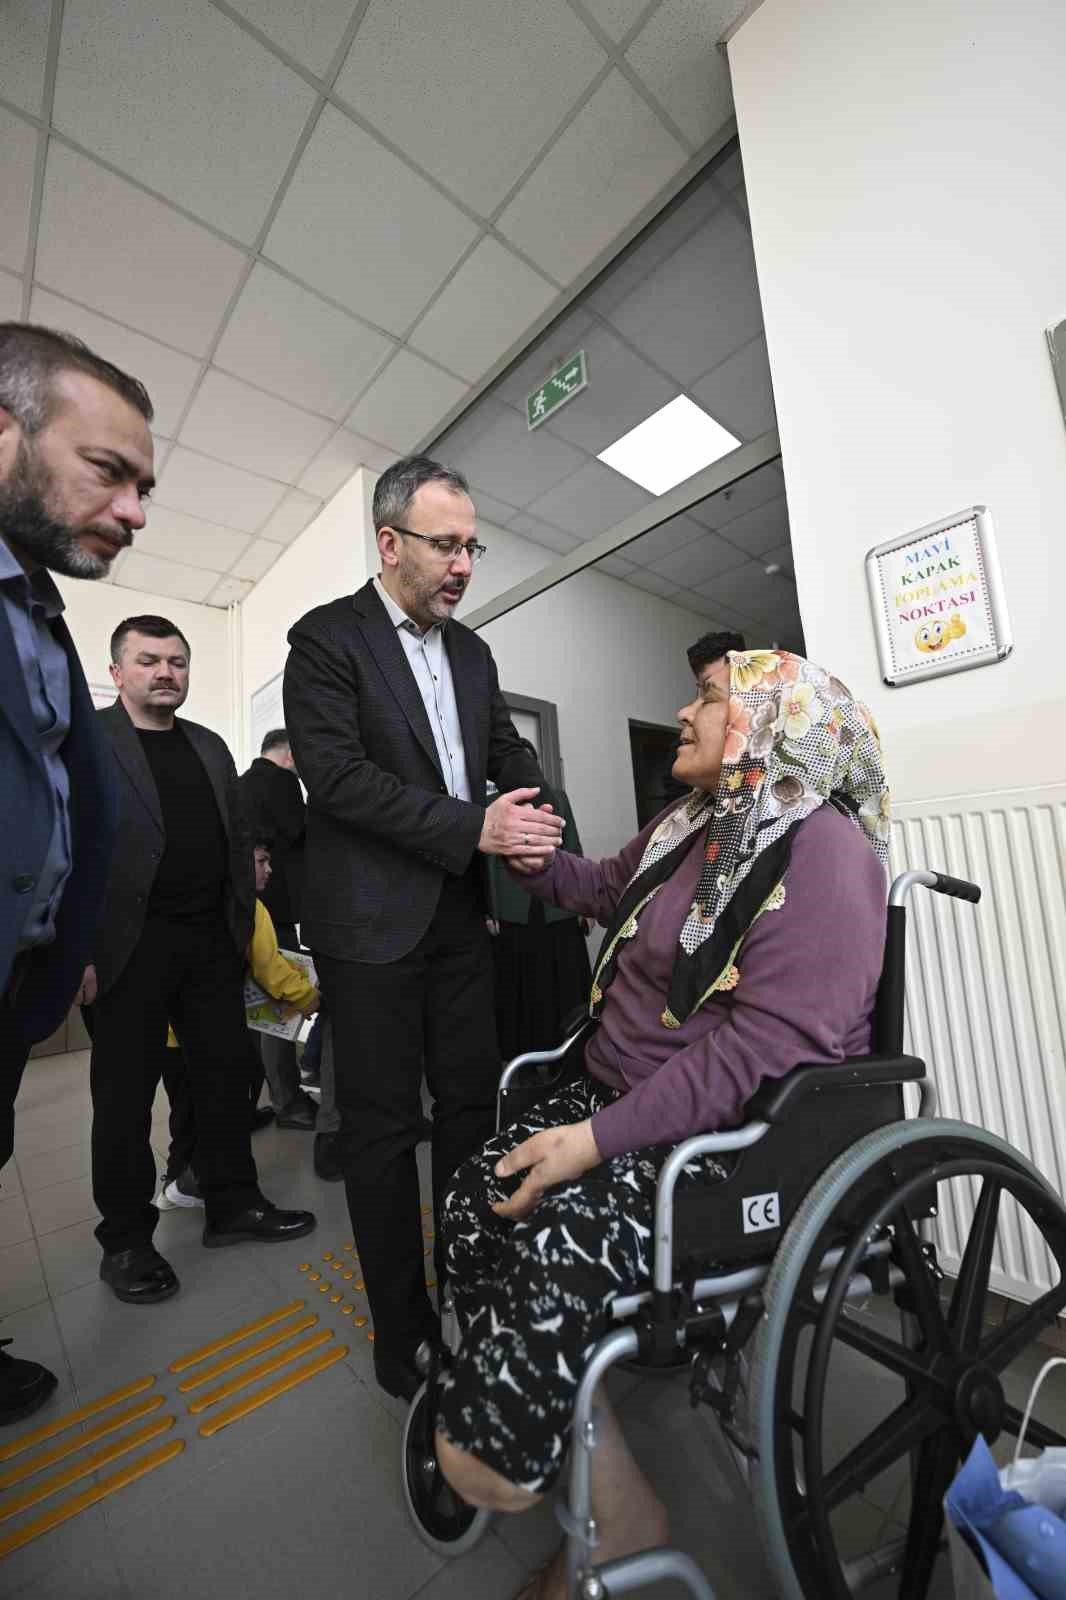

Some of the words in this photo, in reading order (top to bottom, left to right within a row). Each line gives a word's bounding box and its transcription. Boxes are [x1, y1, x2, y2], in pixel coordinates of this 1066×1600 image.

[901, 556, 960, 586] KAPAK
[899, 591, 976, 623] NOKTASI
[747, 1197, 775, 1227] CE
